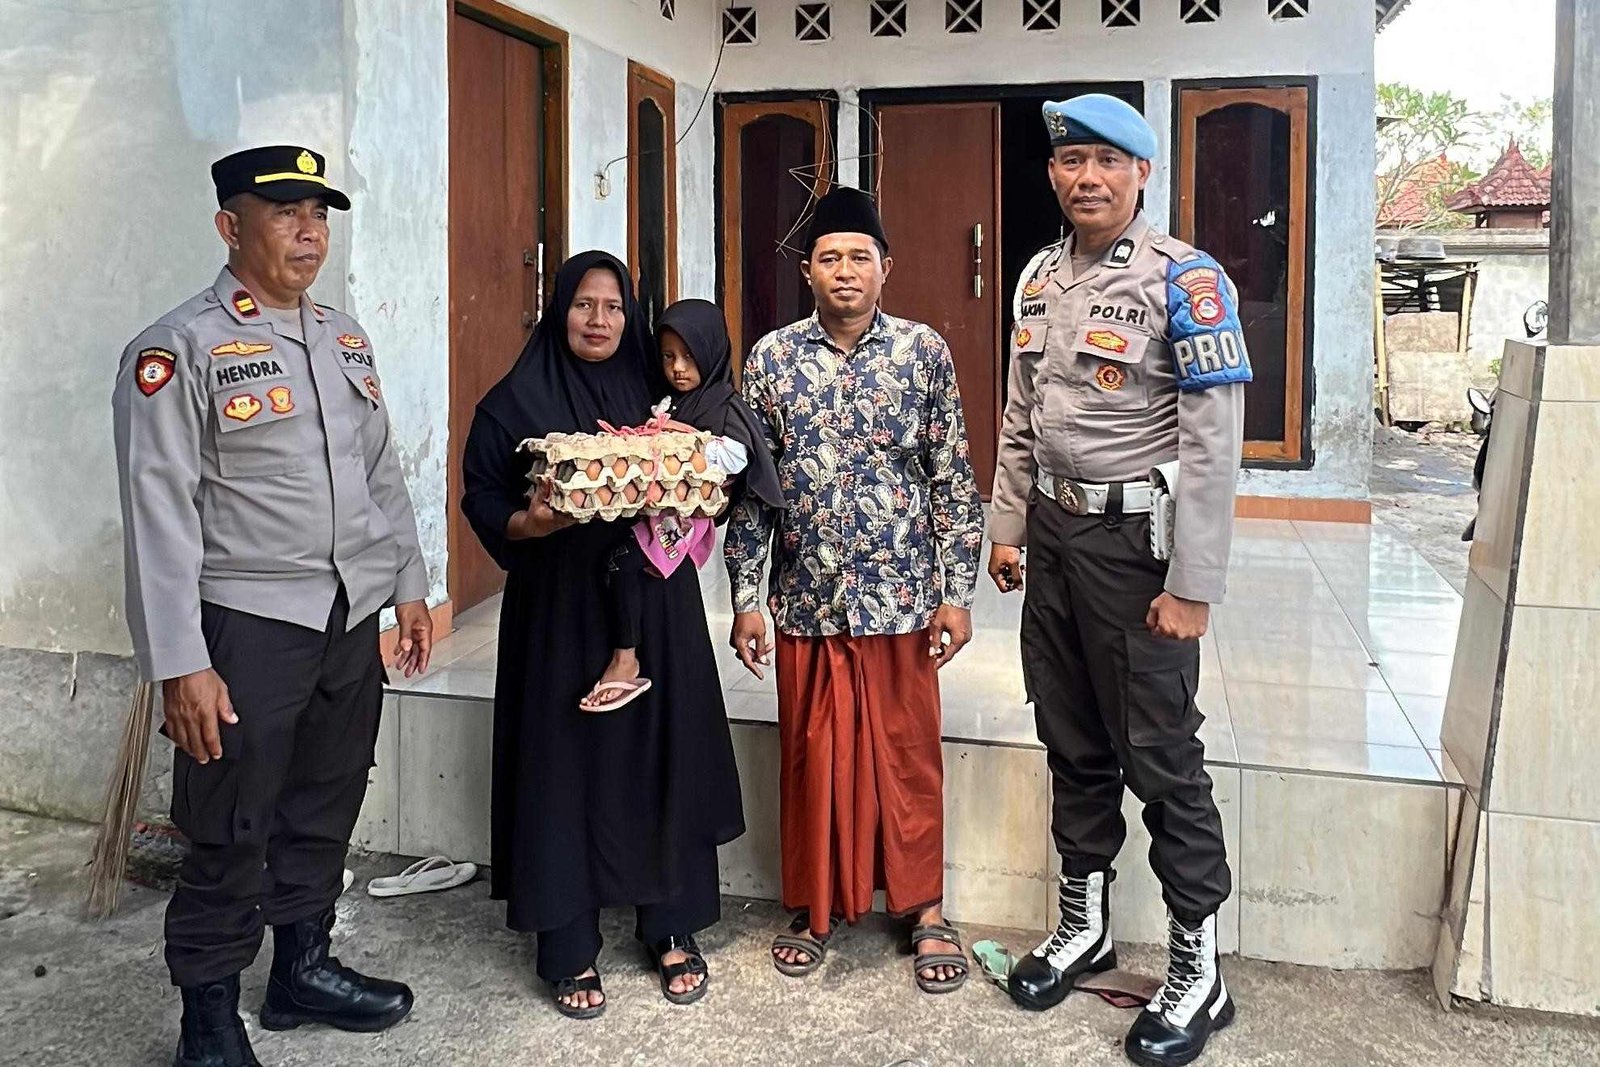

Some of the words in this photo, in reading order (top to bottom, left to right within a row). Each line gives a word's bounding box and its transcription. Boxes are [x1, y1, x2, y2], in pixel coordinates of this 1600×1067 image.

[1089, 304, 1147, 326] POLRI
[1173, 330, 1251, 380] PRO
[216, 360, 284, 387] HENDRA
